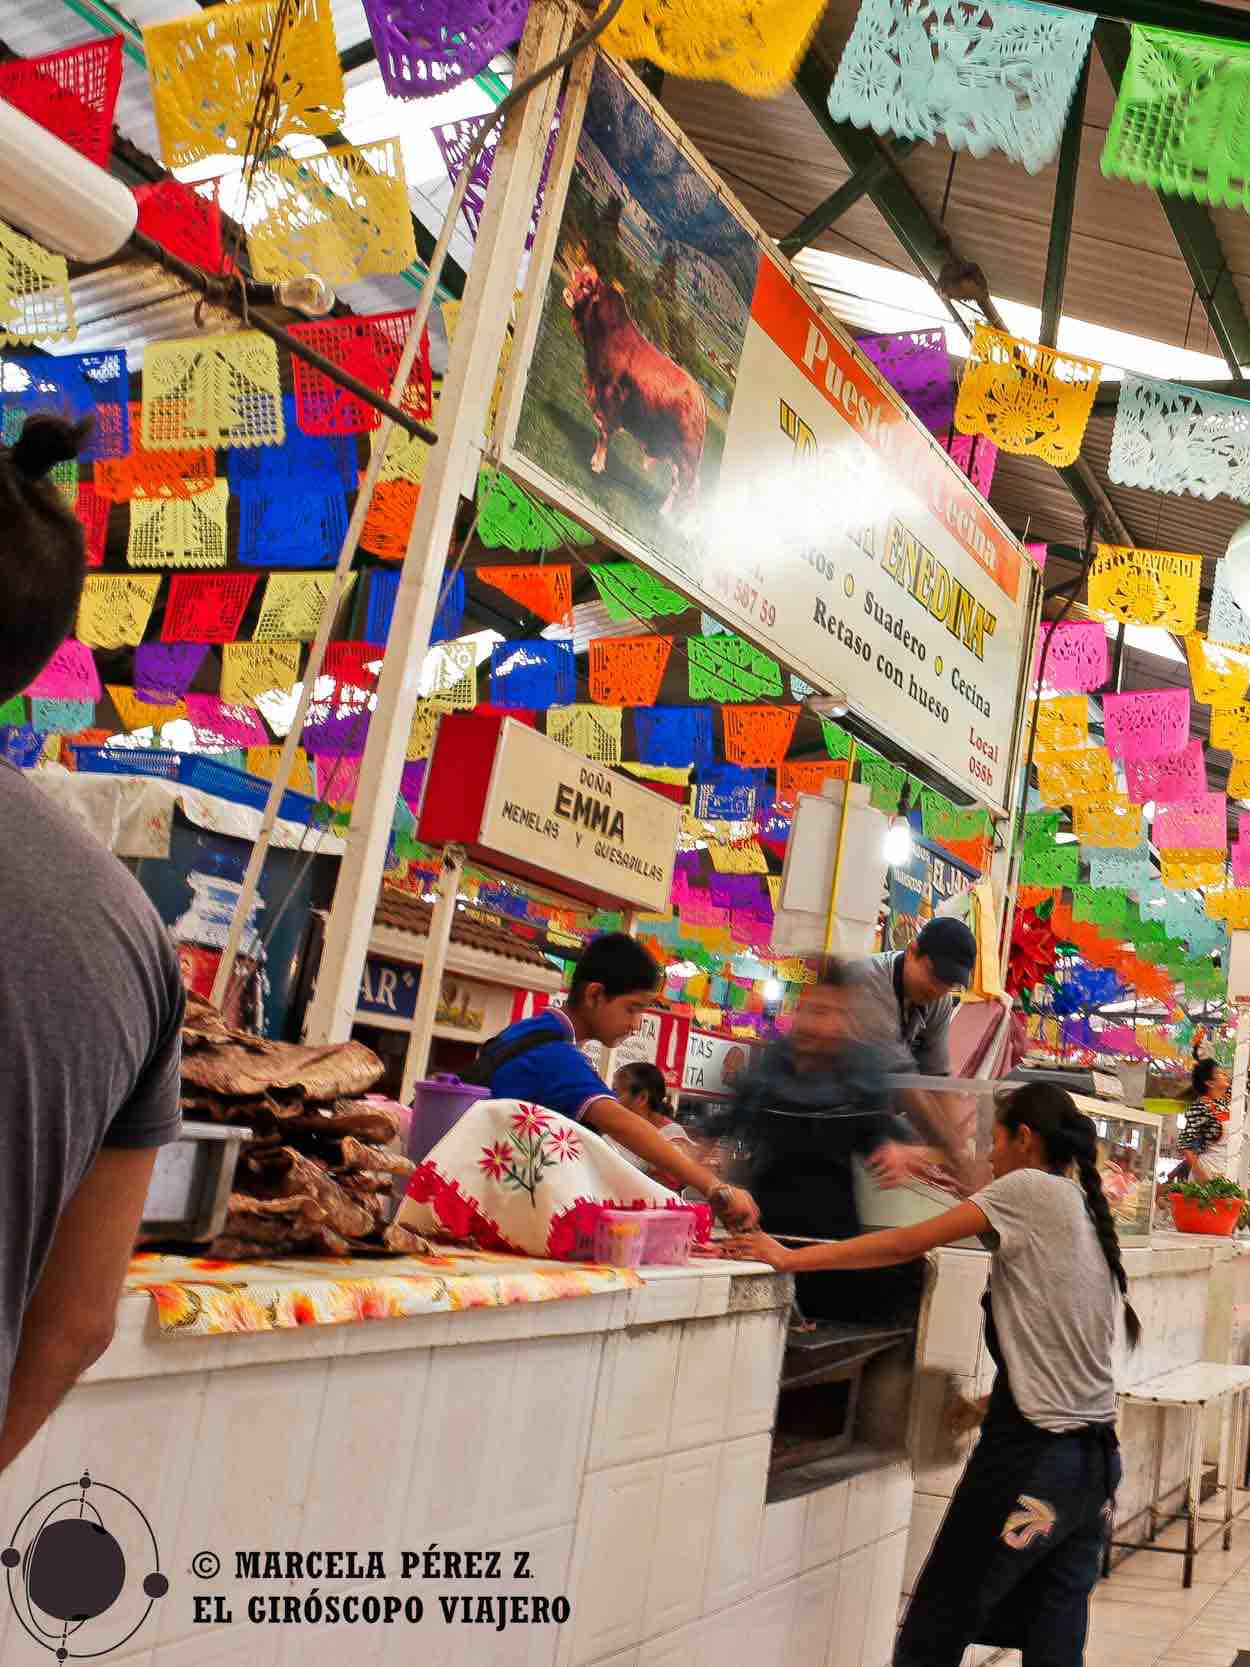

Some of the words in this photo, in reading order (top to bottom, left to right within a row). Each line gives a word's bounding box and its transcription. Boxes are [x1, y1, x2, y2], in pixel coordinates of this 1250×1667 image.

[812, 596, 872, 662] Retaso
[877, 655, 903, 690] con
[908, 674, 950, 724] hueso
[864, 591, 927, 661] Suadero
[951, 668, 992, 719] Cecina
[969, 727, 999, 764] Local
[579, 767, 613, 798] DOÑA
[554, 783, 625, 843] EMMA
[575, 831, 584, 848] Y
[593, 841, 665, 882] QUESADILLAS
[362, 960, 397, 1010] AR
[689, 1036, 714, 1059] TAS
[688, 1065, 705, 1088] TA
